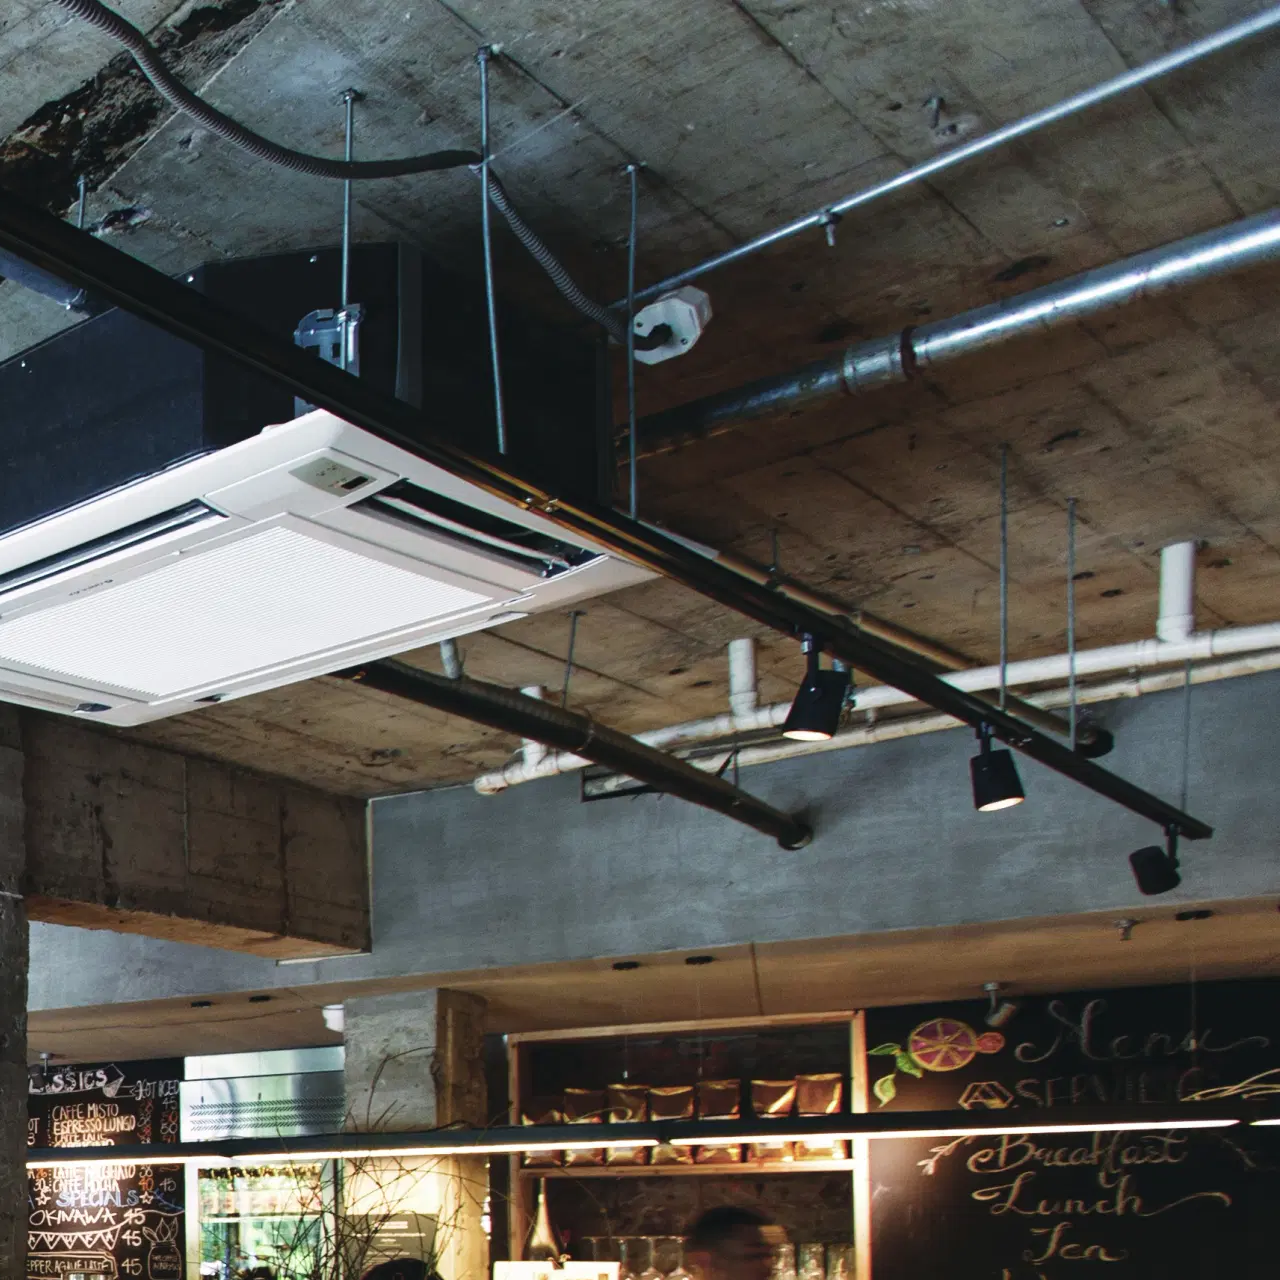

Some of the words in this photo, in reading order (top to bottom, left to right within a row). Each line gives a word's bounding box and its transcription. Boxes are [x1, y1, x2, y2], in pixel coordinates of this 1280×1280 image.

[87, 1102, 119, 1119] MISTO
[53, 1118, 103, 1135] ESPRESSO
[104, 1115, 137, 1132] LUNGO
[966, 1130, 1188, 1188] Breakfast
[56, 1189, 140, 1207] SPECIALS
[971, 1171, 1233, 1216] Lunch
[29, 1207, 117, 1226] OKINAWA
[123, 1208, 146, 1225] 45
[121, 1230, 142, 1247] 45
[1023, 1221, 1129, 1265] Tea
[121, 1258, 143, 1276] 45
